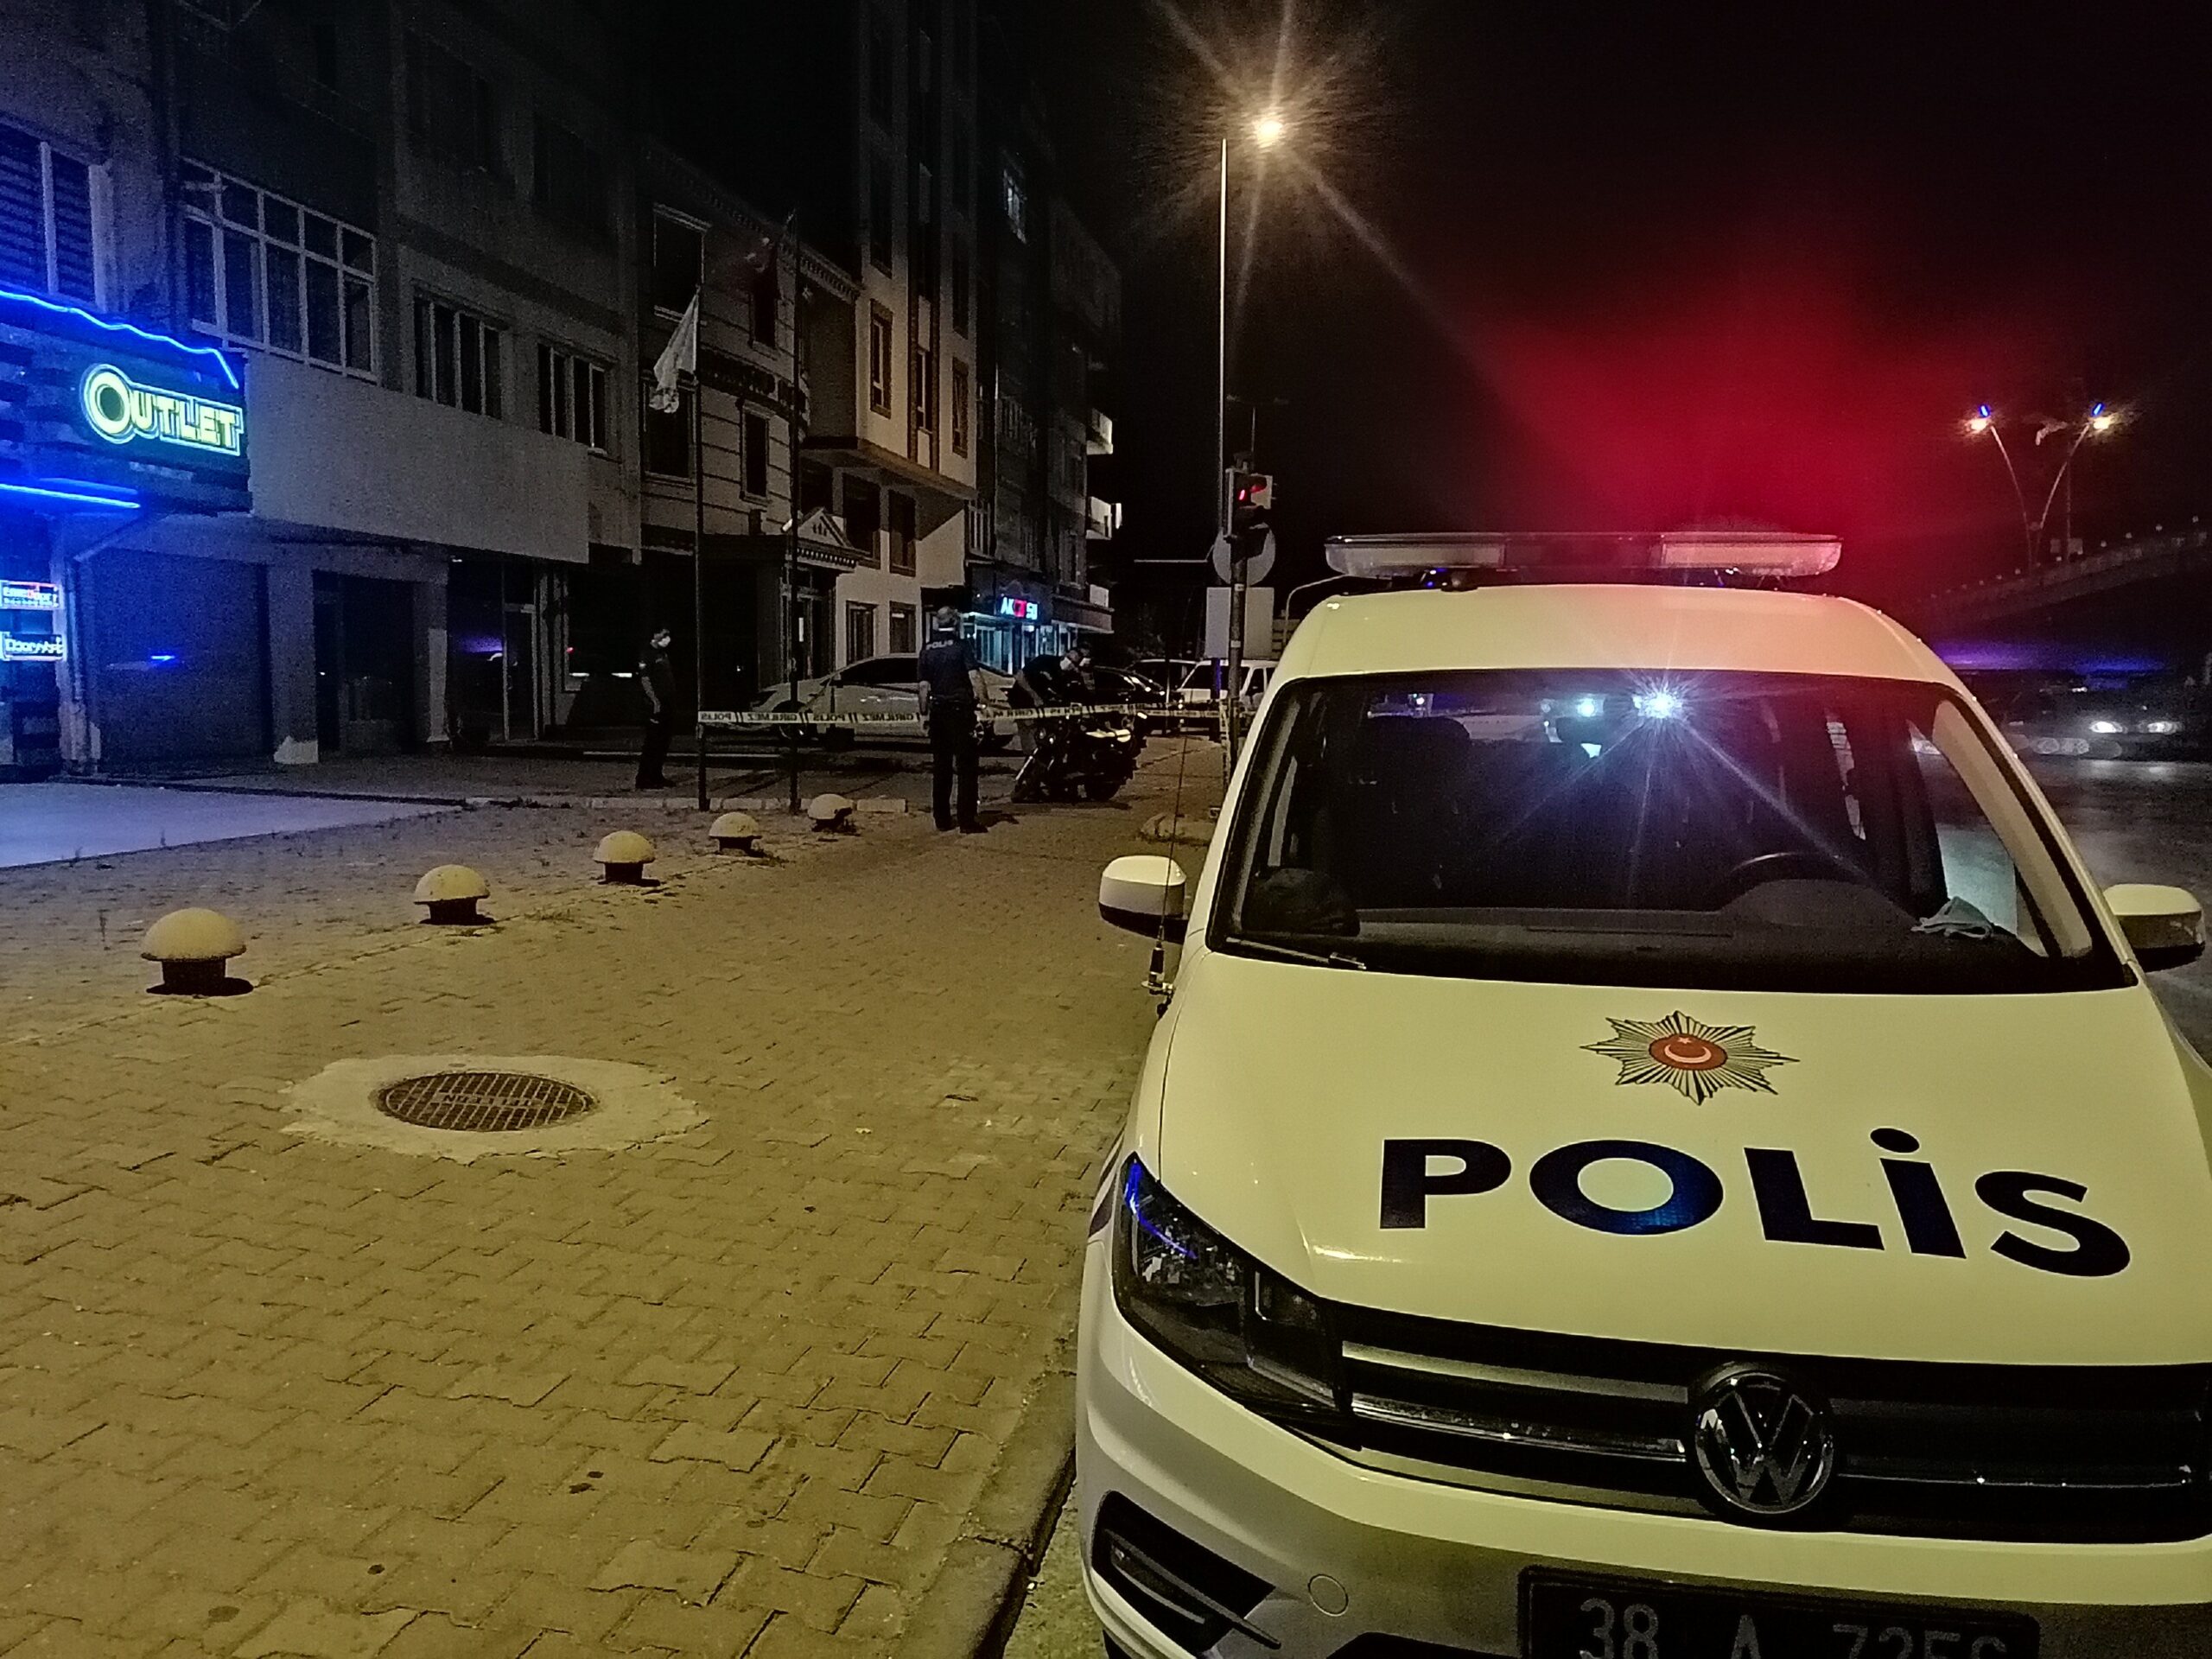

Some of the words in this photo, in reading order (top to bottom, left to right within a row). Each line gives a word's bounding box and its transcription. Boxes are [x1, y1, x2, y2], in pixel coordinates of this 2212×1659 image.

[1378, 1127, 2132, 1278] POLİS
[1579, 1598, 1660, 1659] 38
[1730, 1614, 1763, 1659] A
